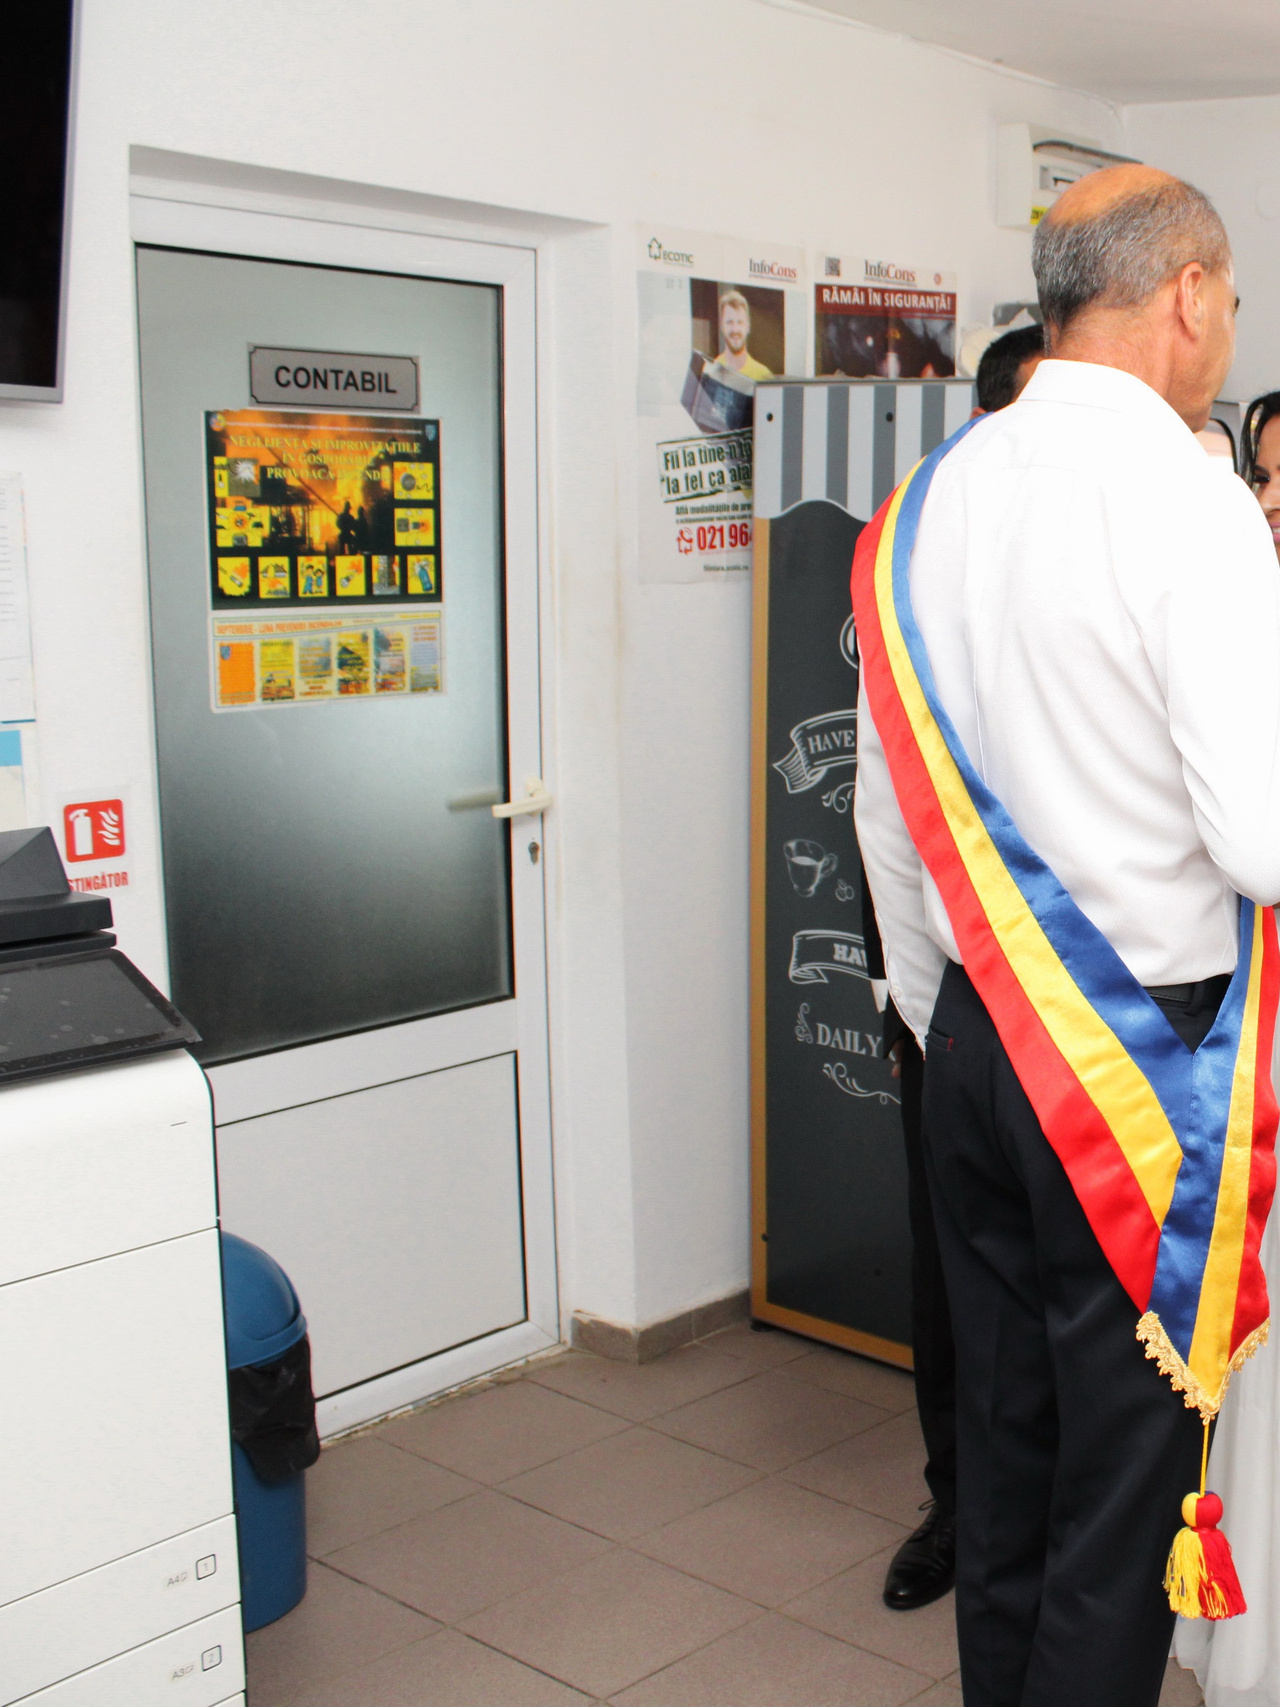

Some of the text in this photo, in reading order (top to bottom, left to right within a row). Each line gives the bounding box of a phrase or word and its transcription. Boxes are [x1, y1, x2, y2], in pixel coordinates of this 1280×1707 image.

[663, 251, 694, 264] ECOTIC
[749, 258, 797, 279] InfoCons
[864, 260, 915, 281] InfoCons
[822, 286, 865, 305] RĂMÂI
[868, 288, 882, 306] ÎN
[275, 365, 397, 394] CONTABIL
[663, 448, 680, 471] Fii
[683, 446, 696, 468] la
[665, 475, 680, 495] la
[685, 470, 703, 492] fel
[708, 469, 725, 487] ca
[697, 523, 752, 551] 021 96
[807, 730, 855, 754] HAVE
[817, 1022, 883, 1058] DAILY
